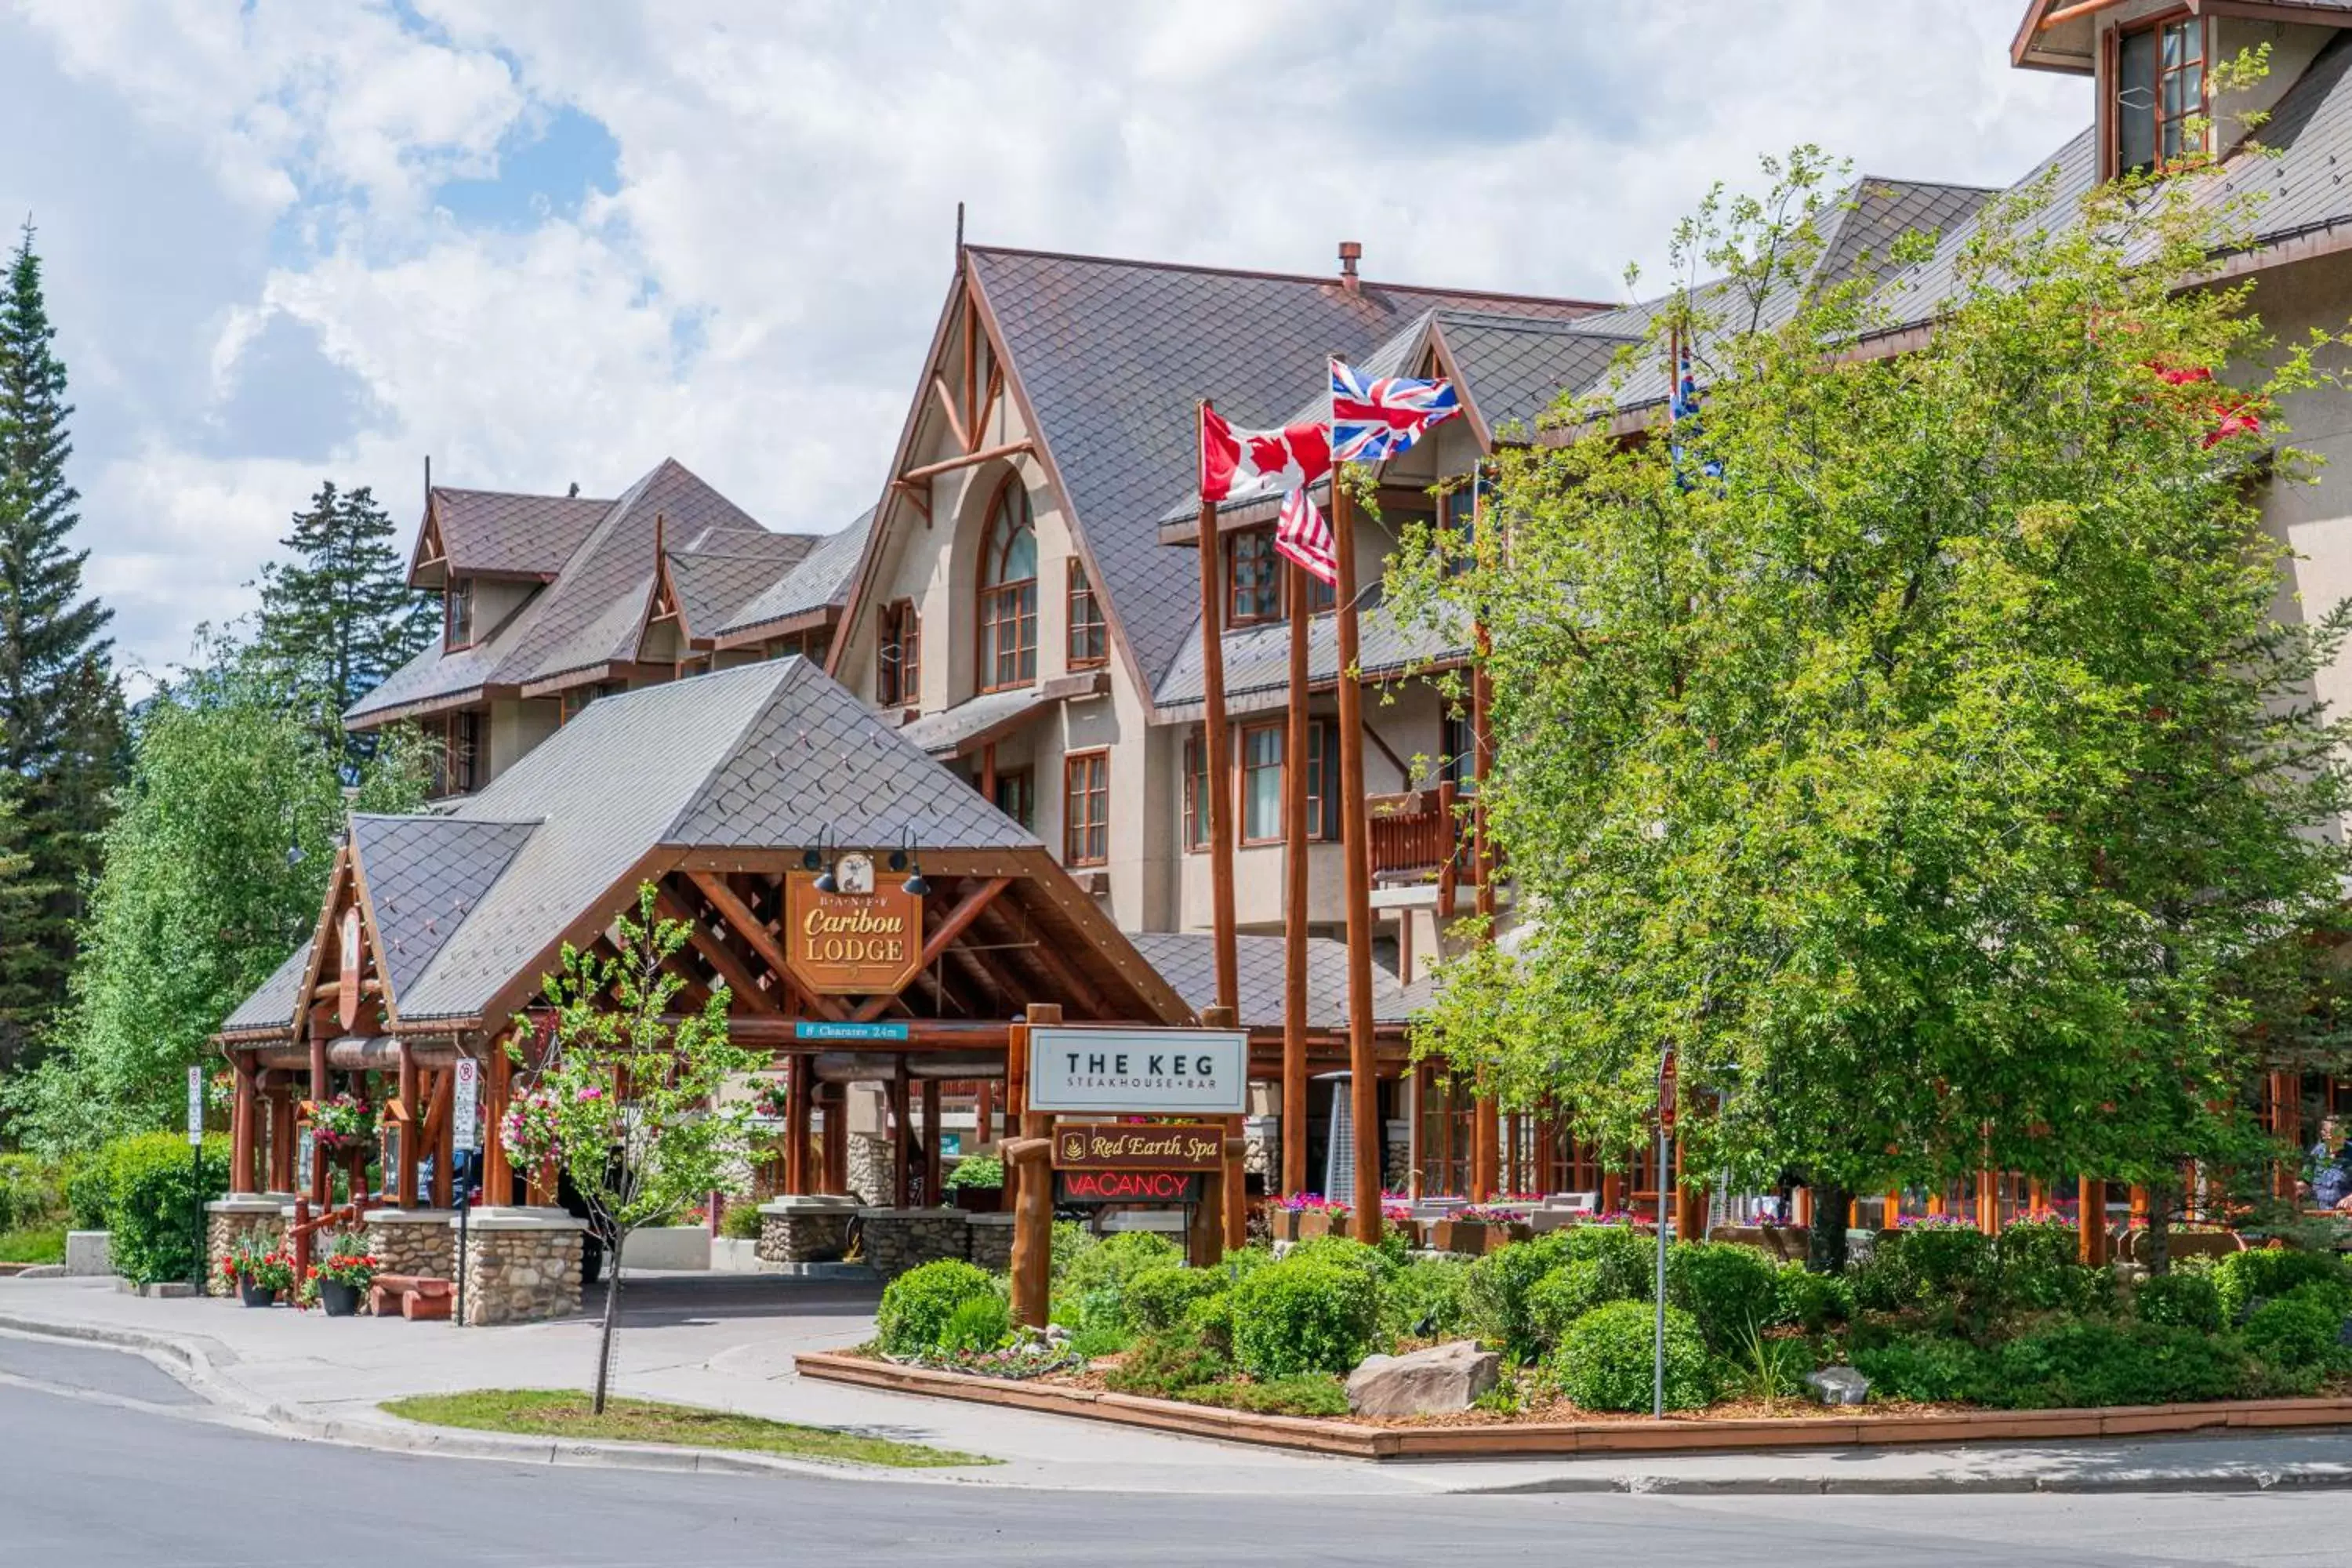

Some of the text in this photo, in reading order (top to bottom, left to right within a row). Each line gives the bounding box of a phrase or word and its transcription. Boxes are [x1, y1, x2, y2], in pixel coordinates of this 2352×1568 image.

[804, 908, 904, 935] Caribou
[806, 938, 904, 960] LODGE
[1067, 1053, 1213, 1075] THE KEG
[1067, 1077, 1173, 1088] STEAKHOUSE
[1187, 1079, 1216, 1089] BAR
[1091, 1135, 1217, 1162] Red Earth Spa
[1067, 1172, 1189, 1196] VACANCY
